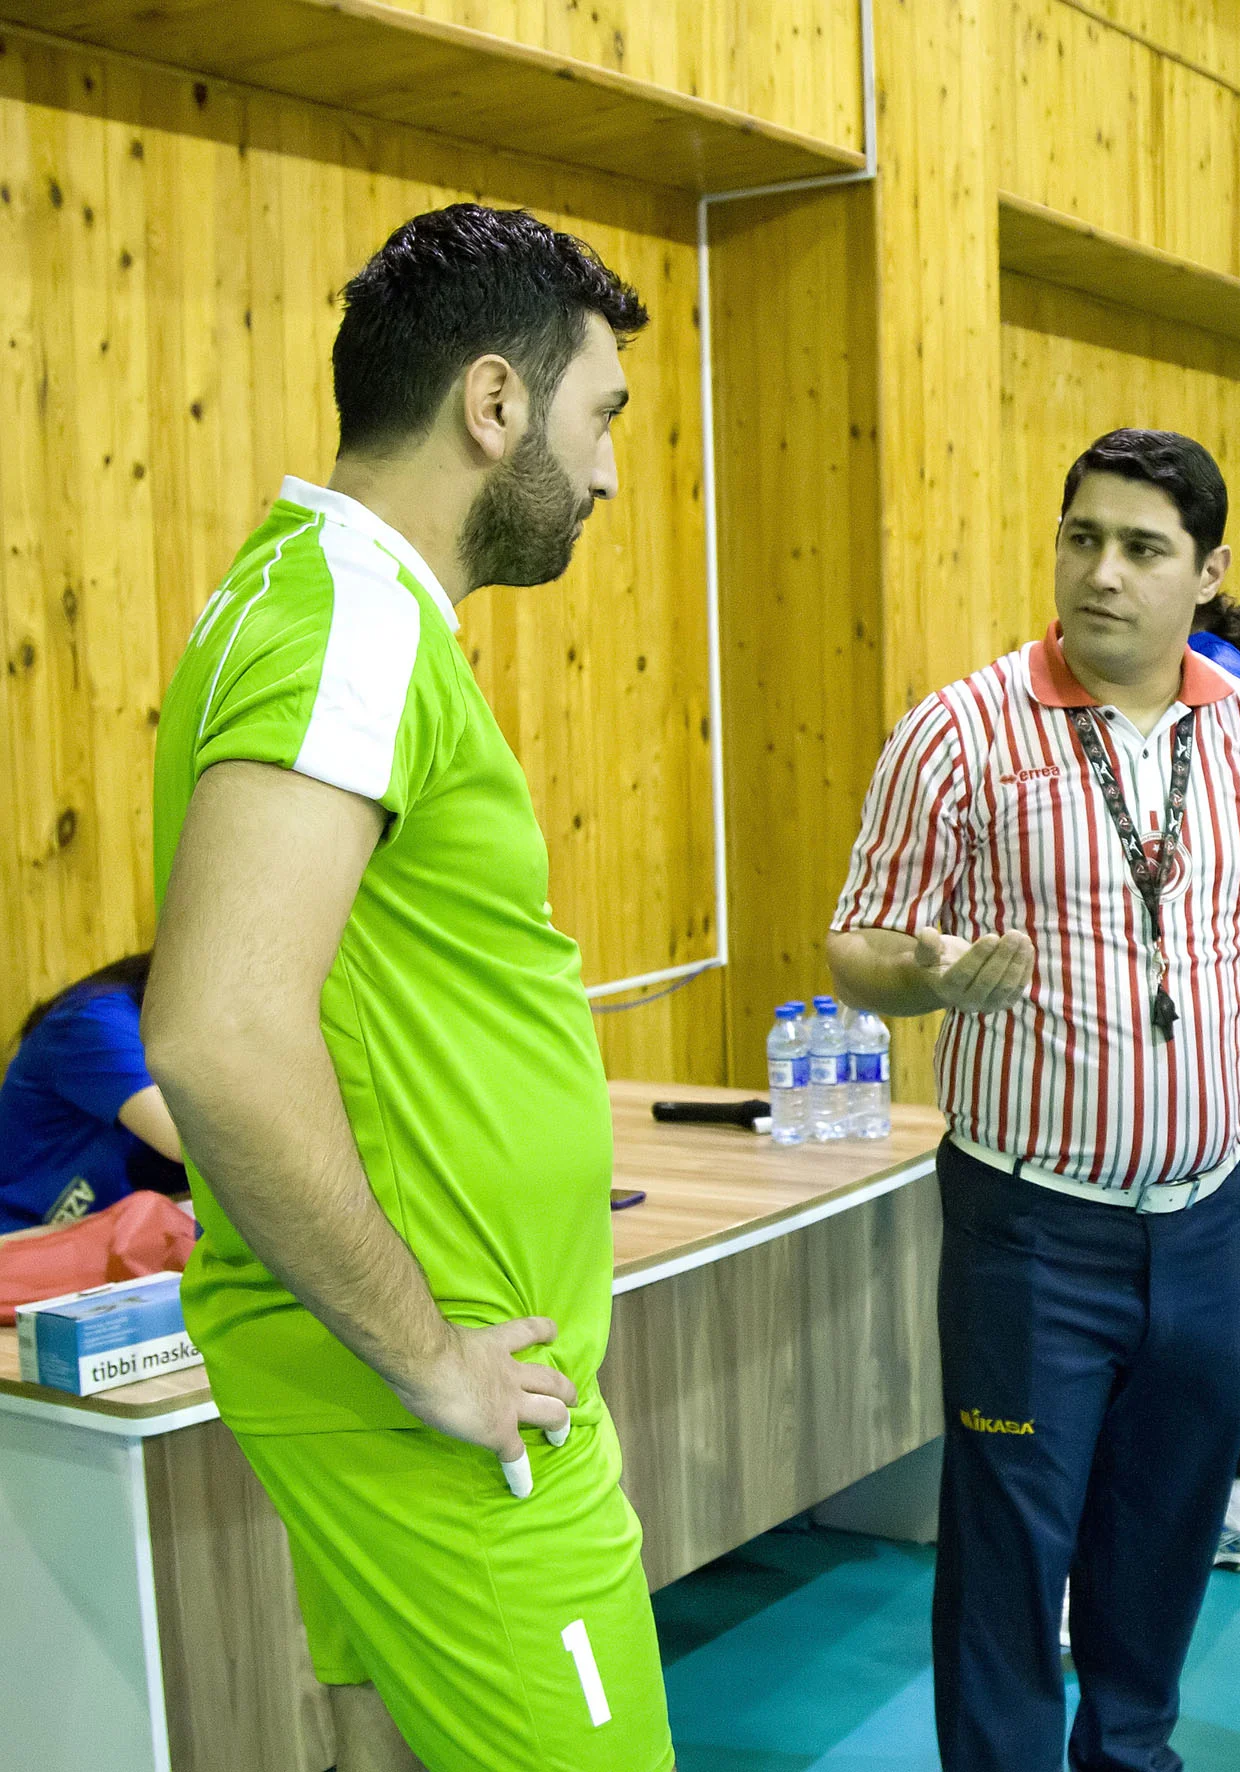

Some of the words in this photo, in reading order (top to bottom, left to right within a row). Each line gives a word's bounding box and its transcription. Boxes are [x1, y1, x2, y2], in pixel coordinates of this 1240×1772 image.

[92, 1354, 137, 1382] tibbi
[143, 1342, 200, 1369] maska
[560, 1618, 612, 1727] 1
